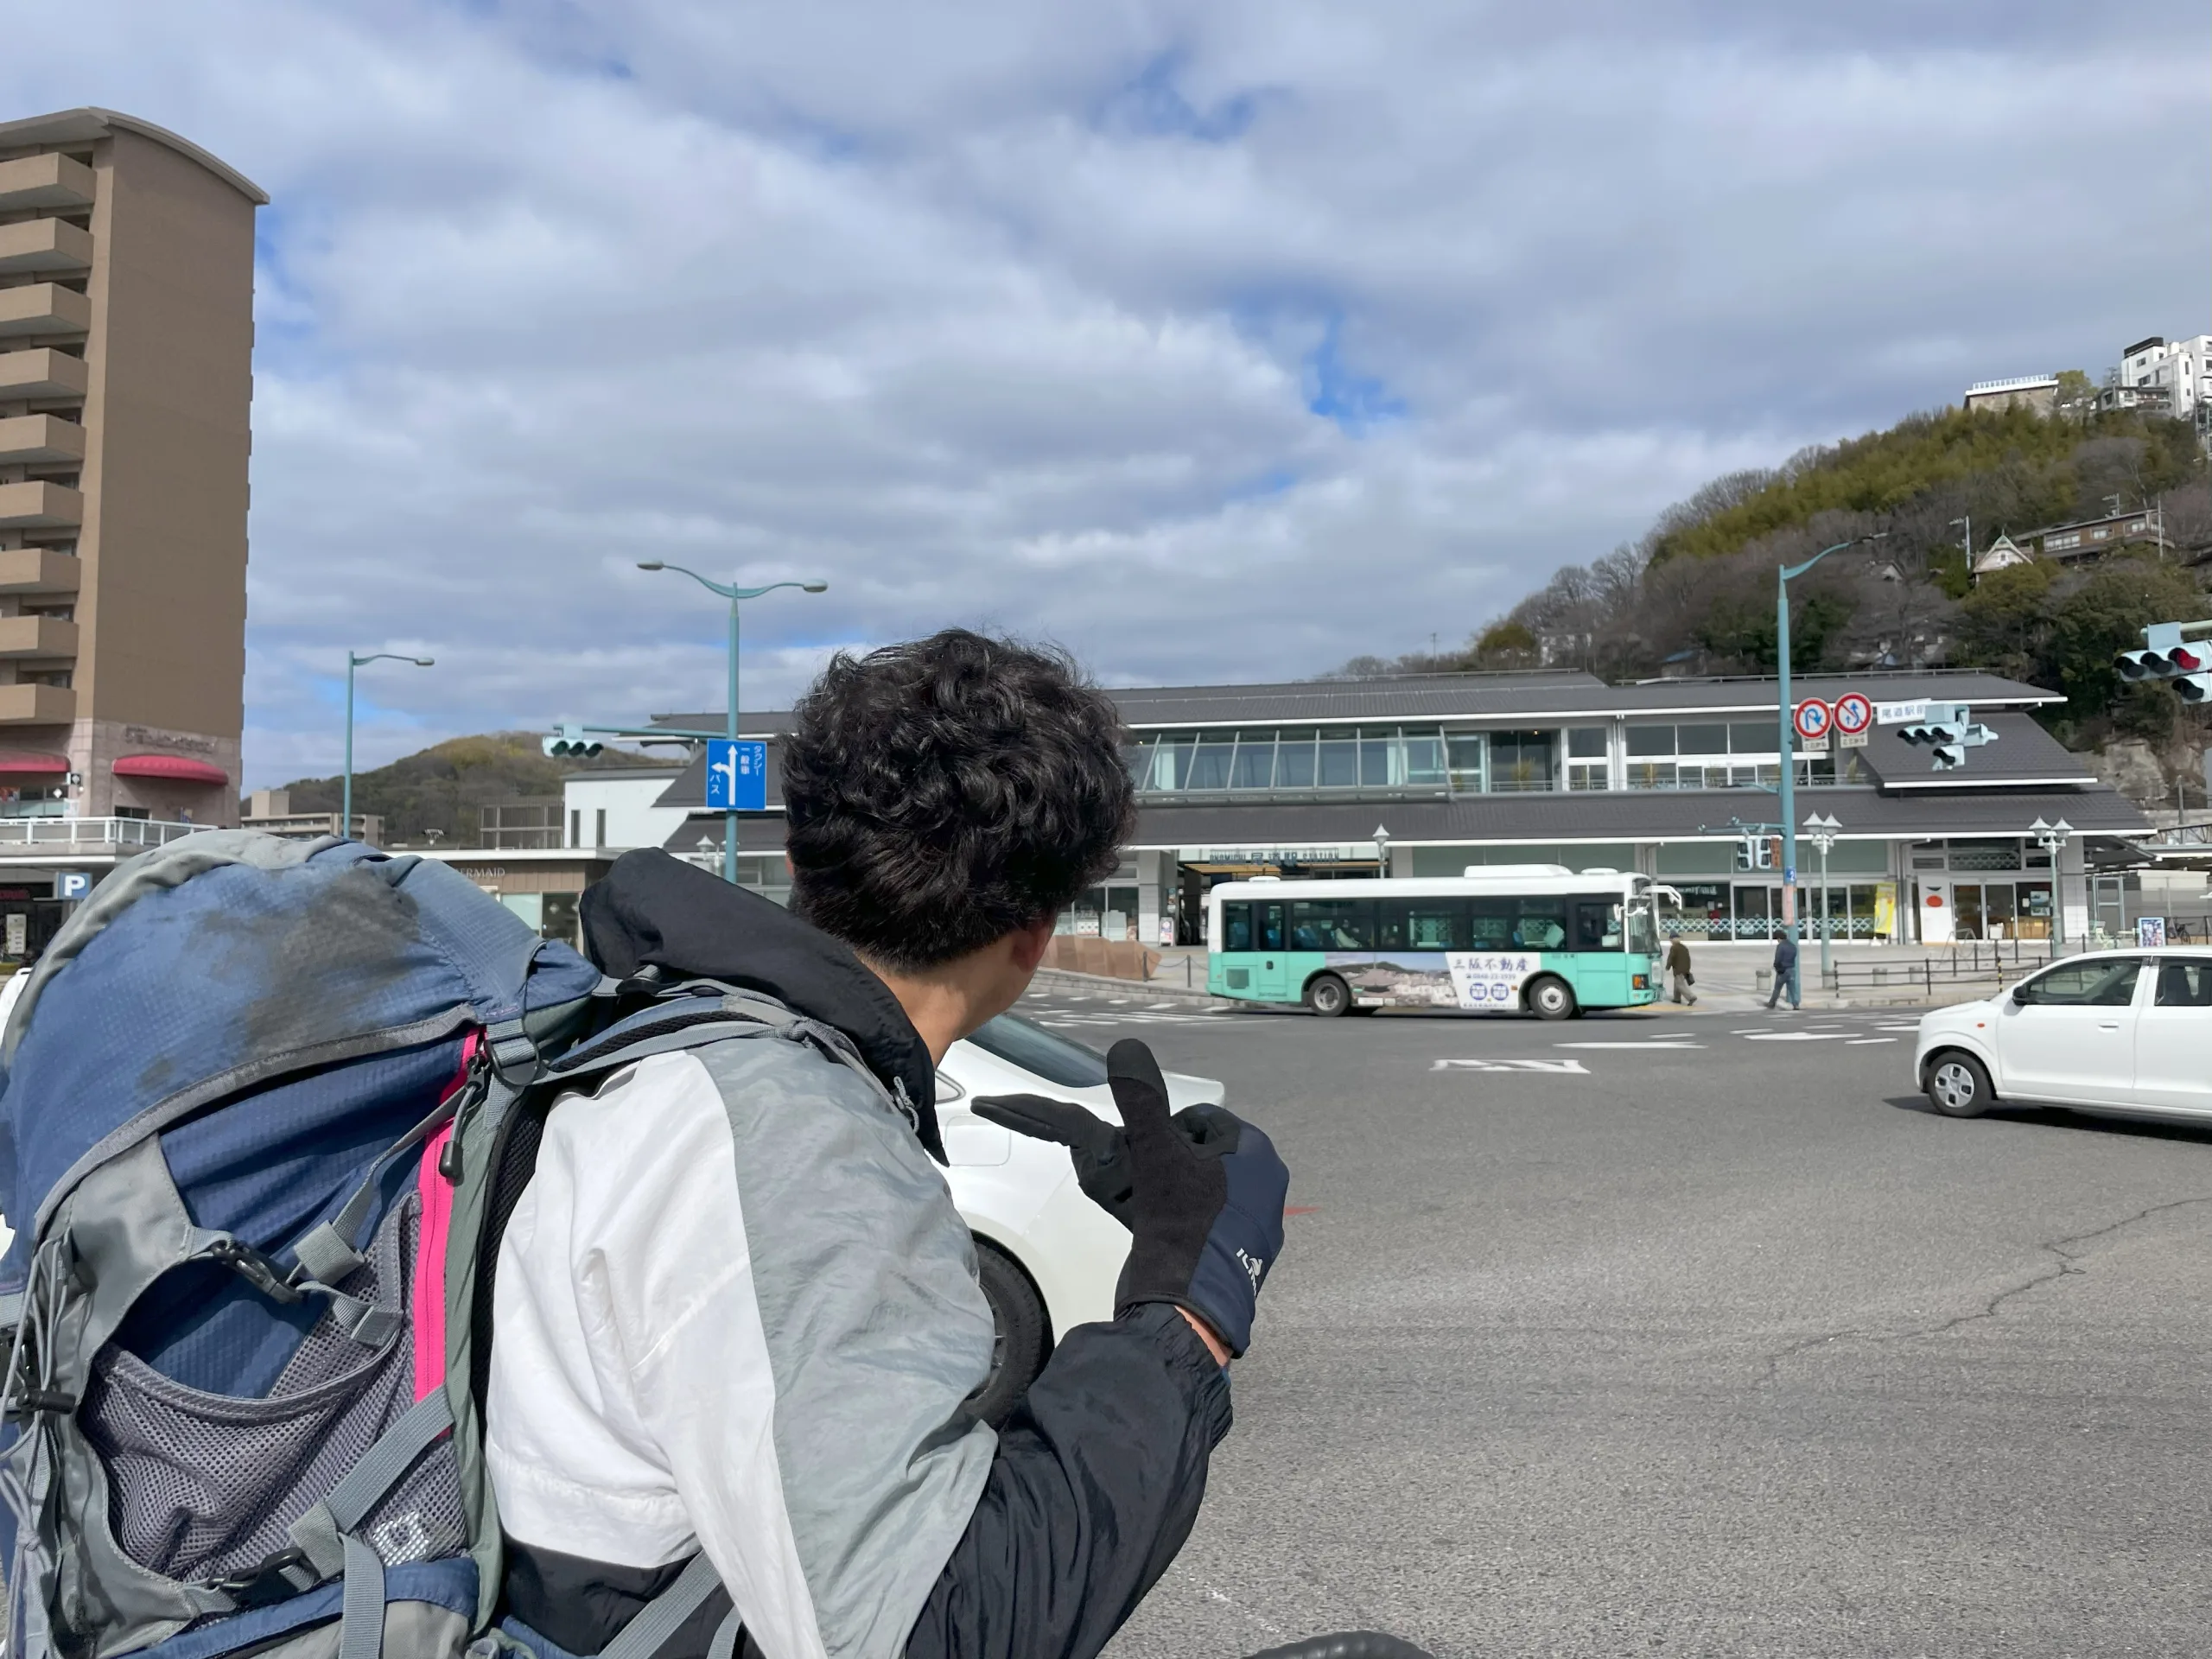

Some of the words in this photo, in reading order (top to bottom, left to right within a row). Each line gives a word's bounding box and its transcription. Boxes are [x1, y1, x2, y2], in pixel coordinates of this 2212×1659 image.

[741, 747, 750, 774] 一般車
[753, 745, 762, 777] タクシー
[709, 774, 721, 795] バス
[65, 875, 86, 897] P
